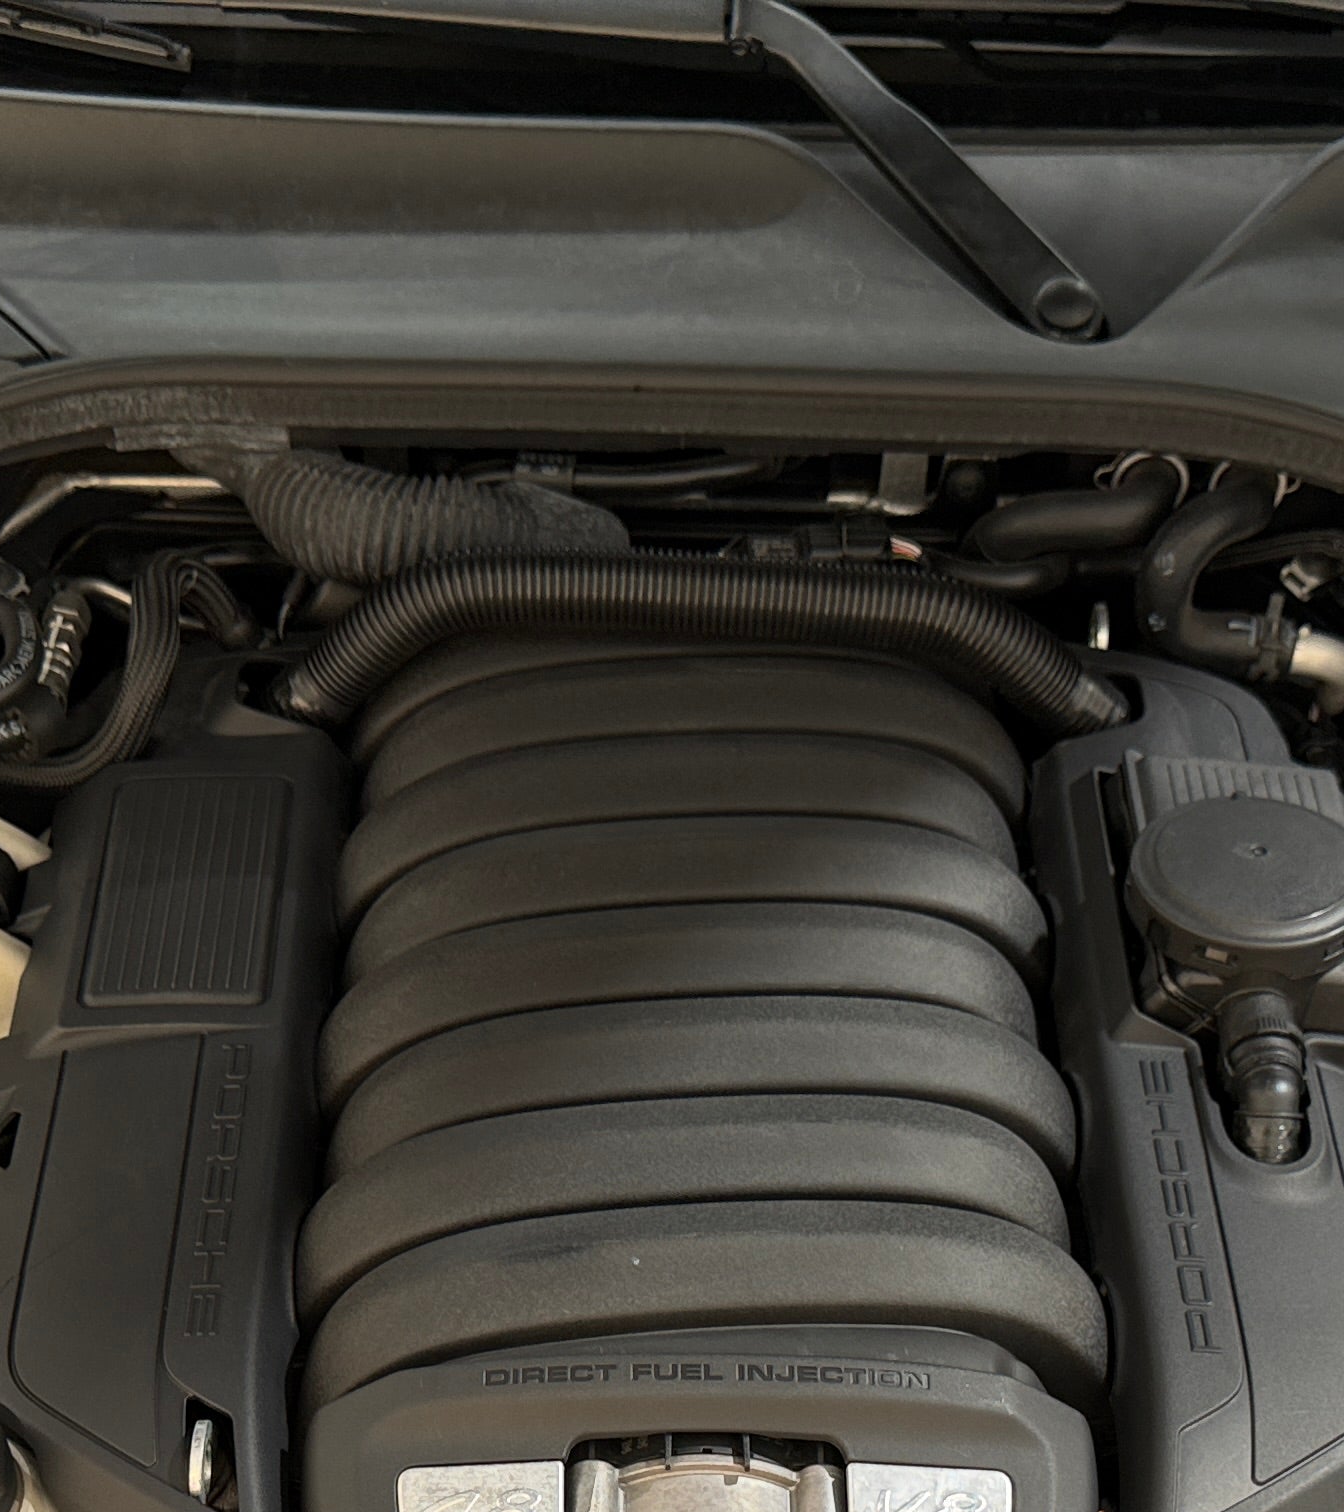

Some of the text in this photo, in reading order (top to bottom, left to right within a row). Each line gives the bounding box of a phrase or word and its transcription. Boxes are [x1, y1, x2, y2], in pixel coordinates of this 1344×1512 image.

[184, 1044, 252, 1336] PORSCHE
[1139, 1060, 1224, 1353] PORSCHE
[483, 1363, 932, 1391] DIRECT FUEL INJECTION
